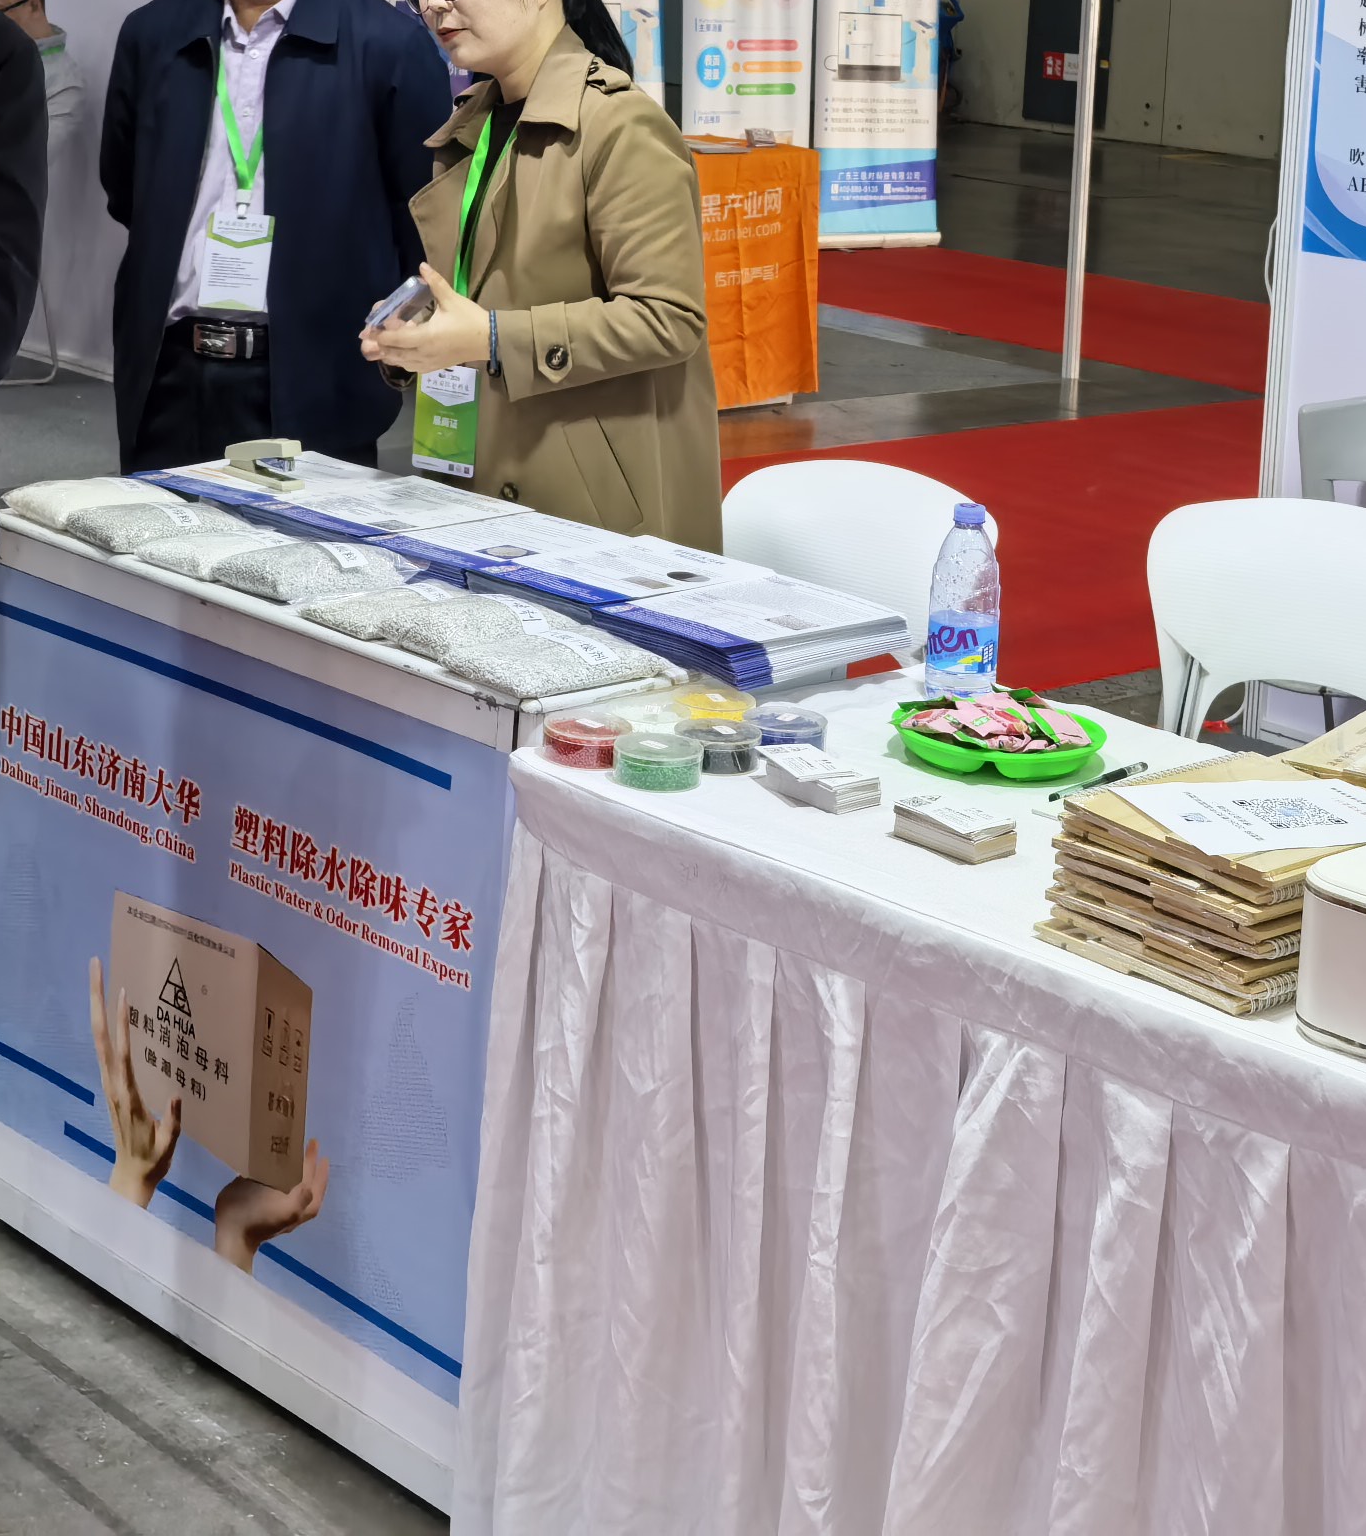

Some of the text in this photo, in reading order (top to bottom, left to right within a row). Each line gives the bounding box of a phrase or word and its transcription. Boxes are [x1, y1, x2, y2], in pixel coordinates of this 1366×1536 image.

[0, 706, 201, 825] 中国山东济南大华
[0, 756, 196, 863] Dahua, Jinan, Shandong, China
[230, 861, 471, 990] Plastic Water & Odor Removal Expert
[231, 804, 474, 953] 塑料除水除味专家
[129, 1006, 229, 1085] 塑料消泡母料
[157, 1005, 196, 1040] DA HUA
